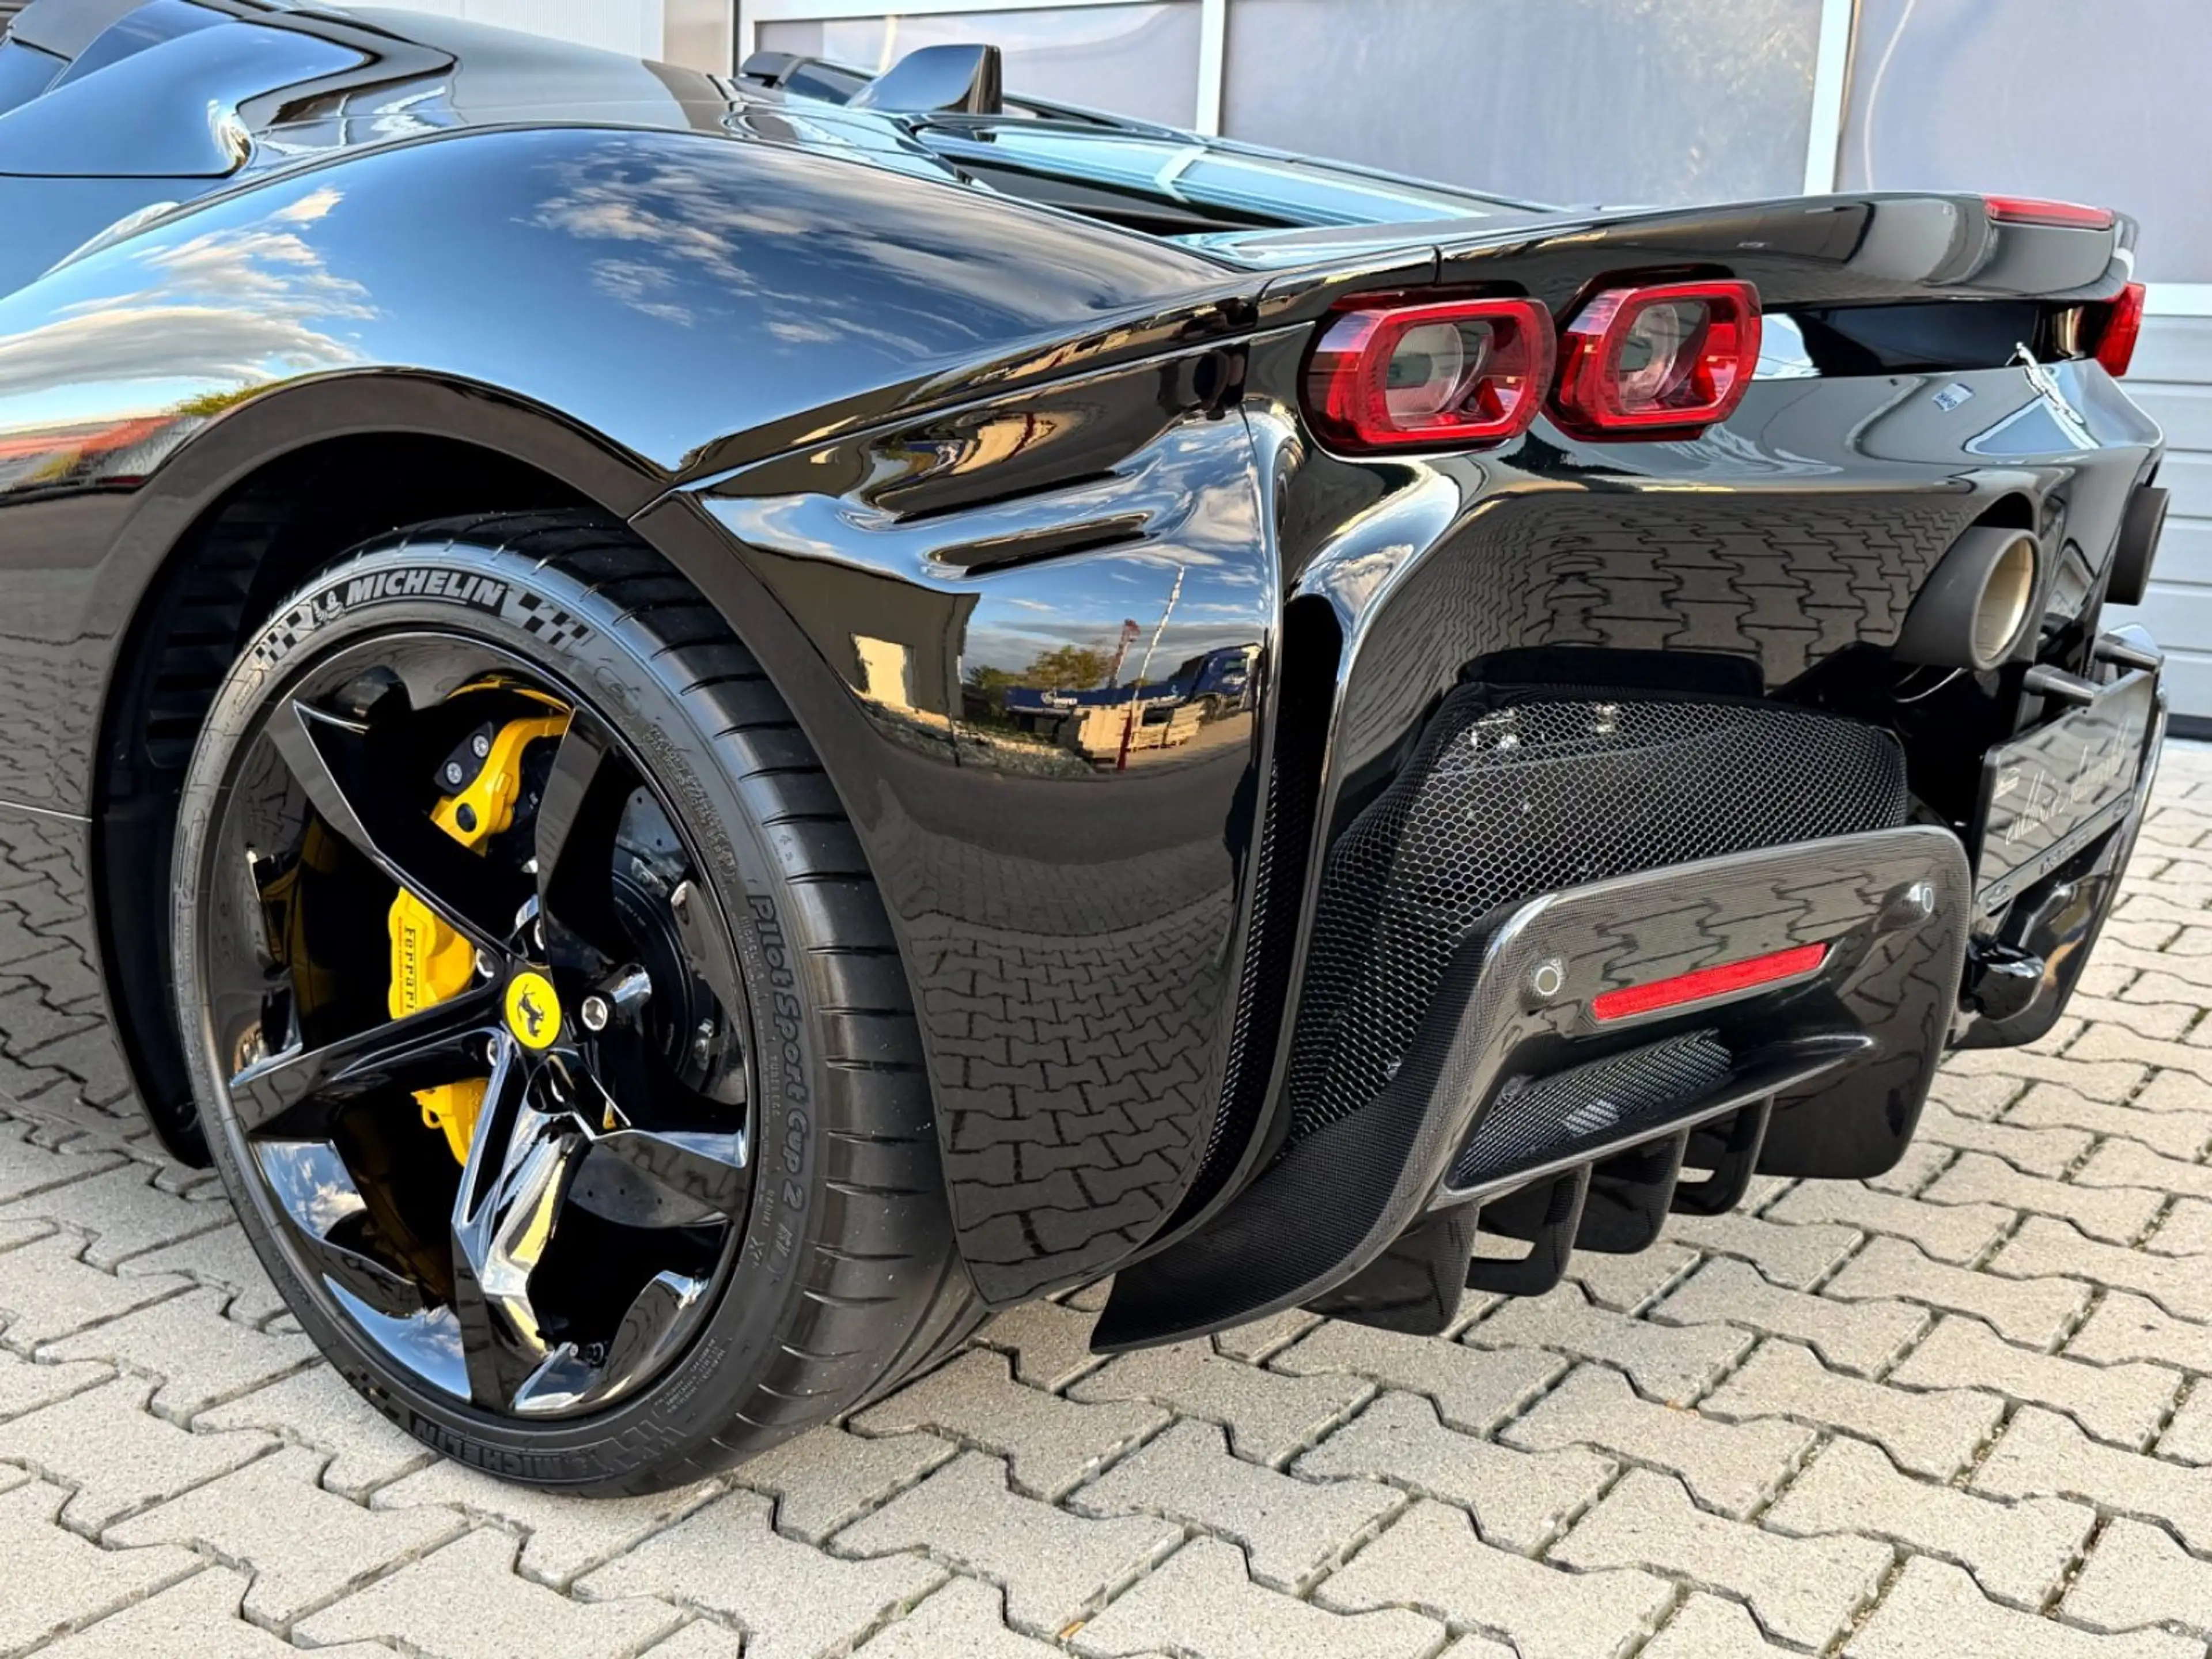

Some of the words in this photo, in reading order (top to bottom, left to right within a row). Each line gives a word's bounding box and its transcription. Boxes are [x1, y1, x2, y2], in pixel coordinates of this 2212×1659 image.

[347, 569, 505, 607] MICHELIN
[405, 926, 416, 1009] Ferrari
[773, 991, 809, 1105] Sport
[782, 1108, 809, 1174] Cup
[782, 1178, 804, 1211] 2
[414, 1418, 563, 1478] MICHELIN
